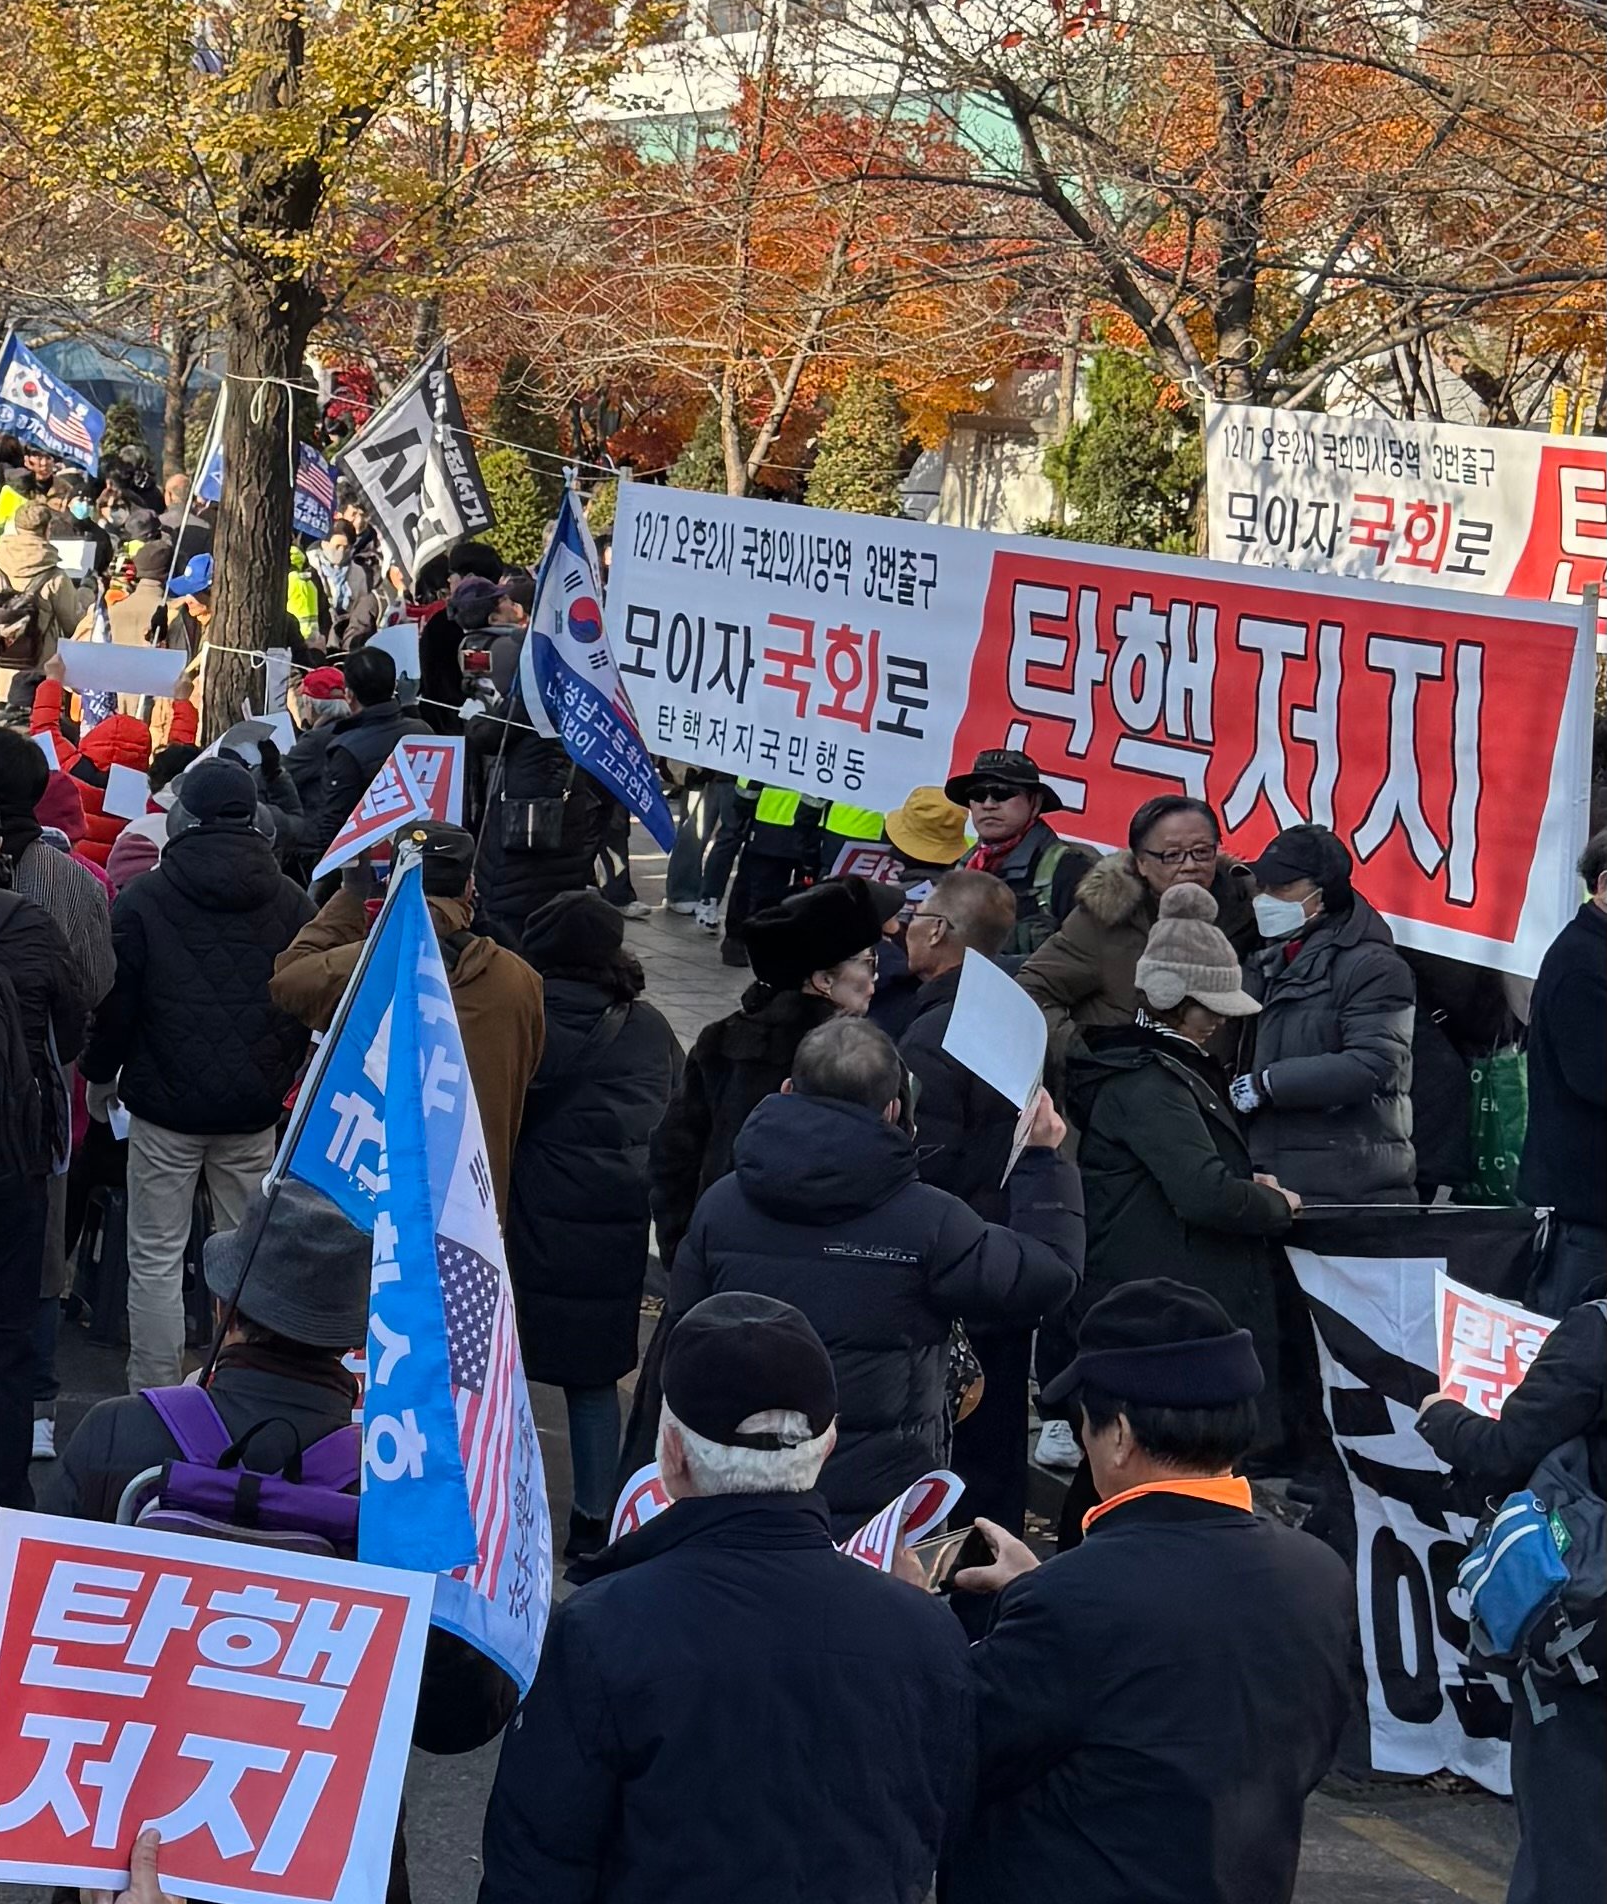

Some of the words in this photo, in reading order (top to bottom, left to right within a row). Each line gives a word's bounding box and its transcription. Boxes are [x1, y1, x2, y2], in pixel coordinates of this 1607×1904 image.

[1223, 424, 1255, 462] 12/7
[1261, 429, 1316, 469] 오후2시
[1323, 433, 1422, 481] 국회의사당역
[1432, 444, 1496, 489] 3번출구
[633, 511, 669, 562] 12/7
[672, 515, 736, 576] 오후2시
[741, 526, 853, 597] 국회의사당역
[863, 545, 939, 610] 3번출구
[1225, 491, 1343, 560] 모이자
[1348, 492, 1495, 577] 국회로
[619, 603, 756, 705] 모이자
[762, 612, 930, 740] 국회로
[1006, 578, 1486, 907] 탄핵저지
[20, 1559, 385, 1733] 탄핵
